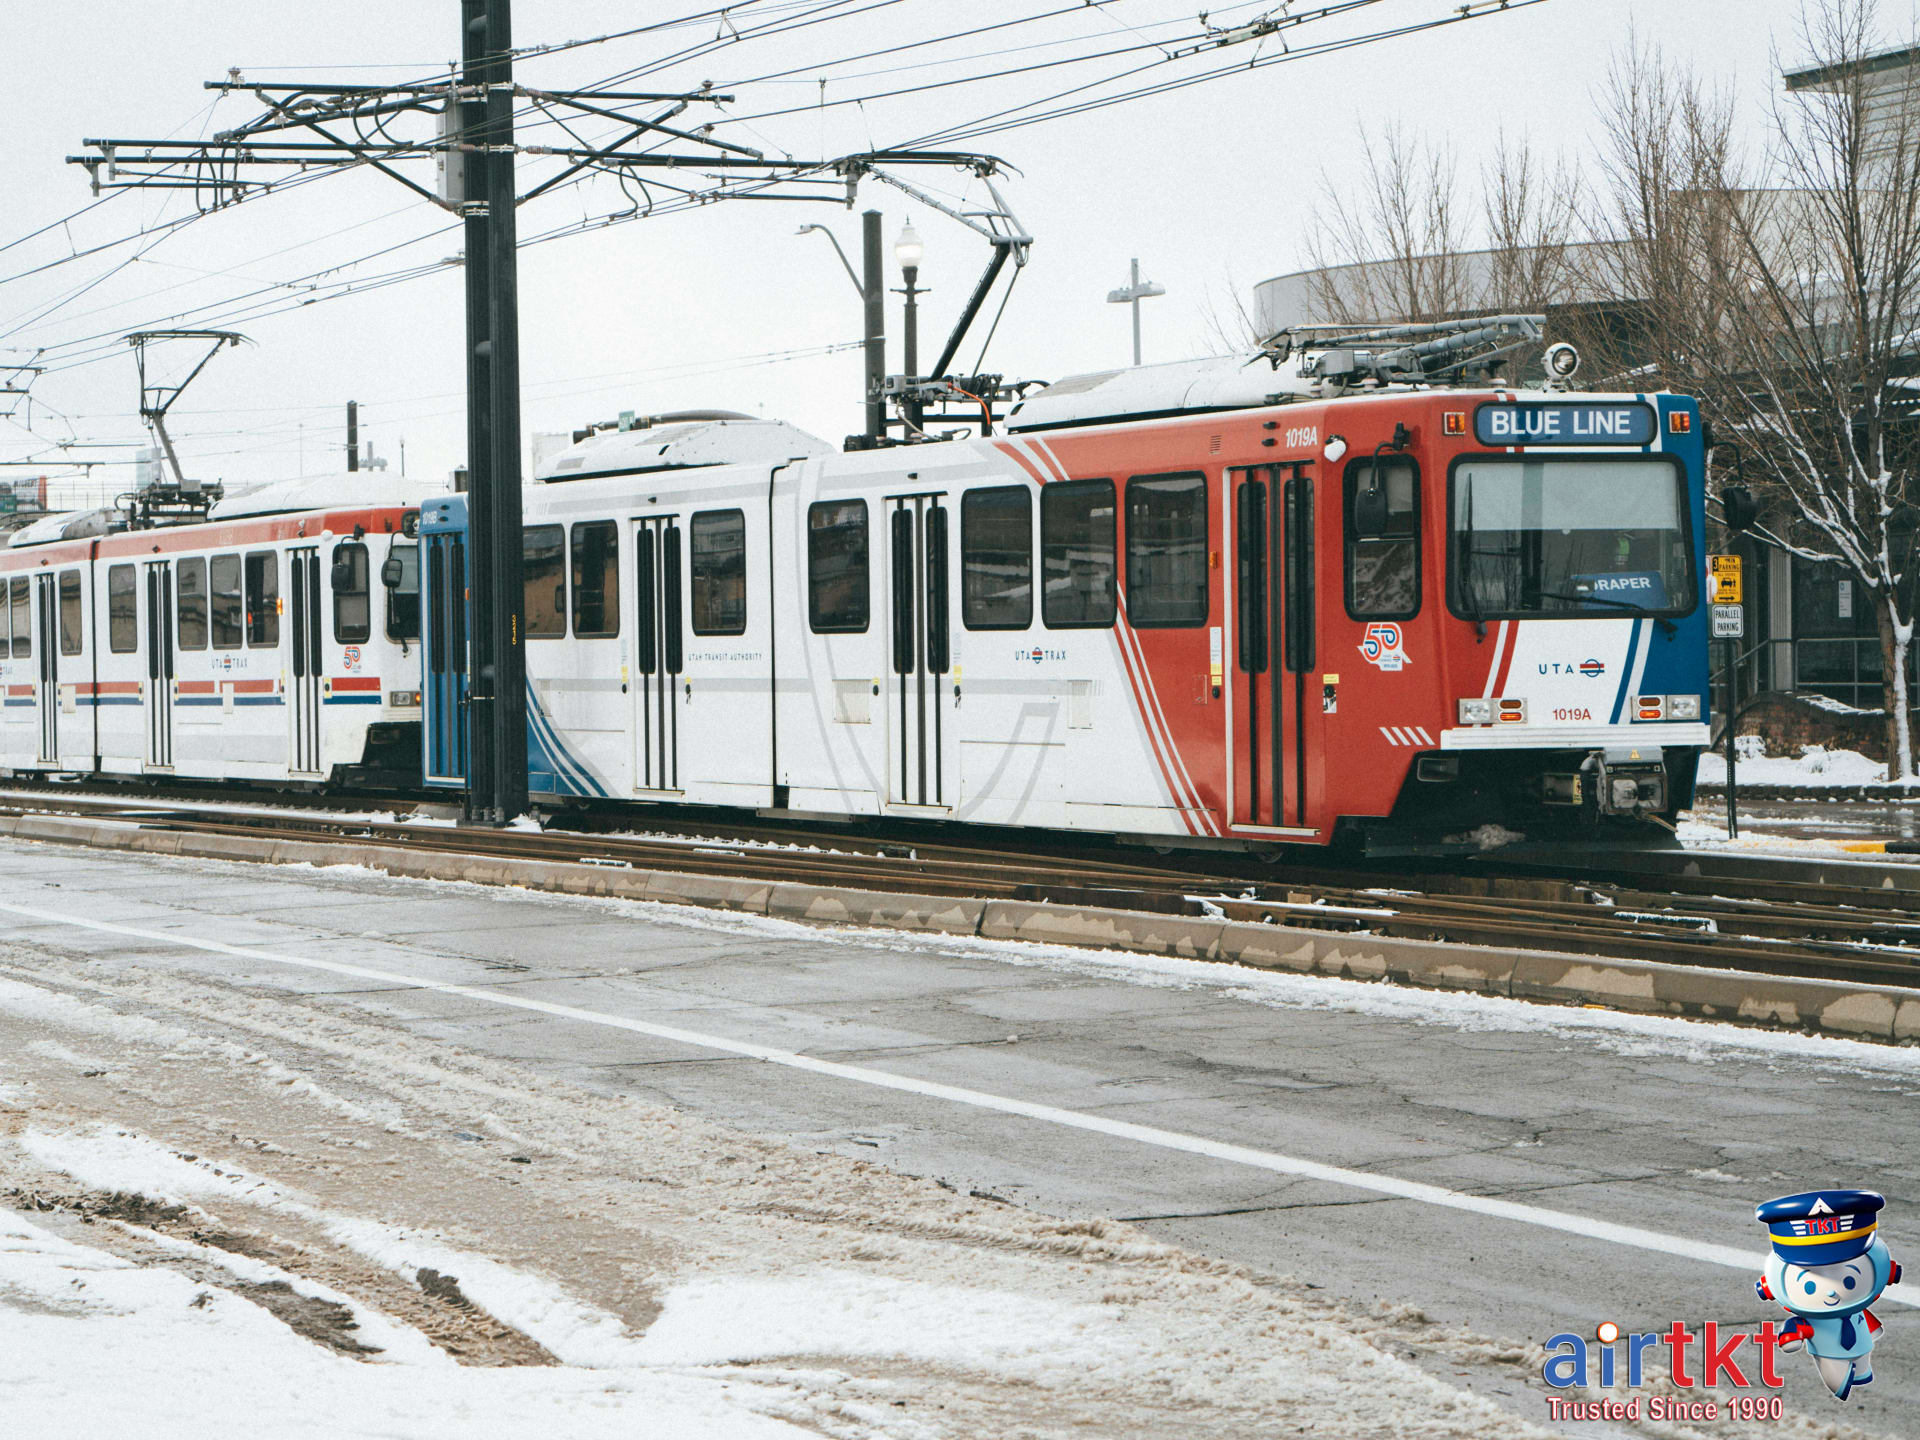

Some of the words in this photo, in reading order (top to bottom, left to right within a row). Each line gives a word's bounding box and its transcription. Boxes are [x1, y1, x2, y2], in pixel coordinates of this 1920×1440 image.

[1491, 410, 1561, 435] BLUE
[1573, 410, 1631, 435] LINE
[1286, 426, 1318, 448] 1019A
[1715, 609, 1740, 619] PARALLEL
[1717, 622, 1739, 632] PARKING
[1015, 650, 1031, 661] UTA
[1044, 650, 1067, 661] TRAX
[1538, 663, 1575, 675] UTA
[1552, 708, 1592, 721] 1019A
